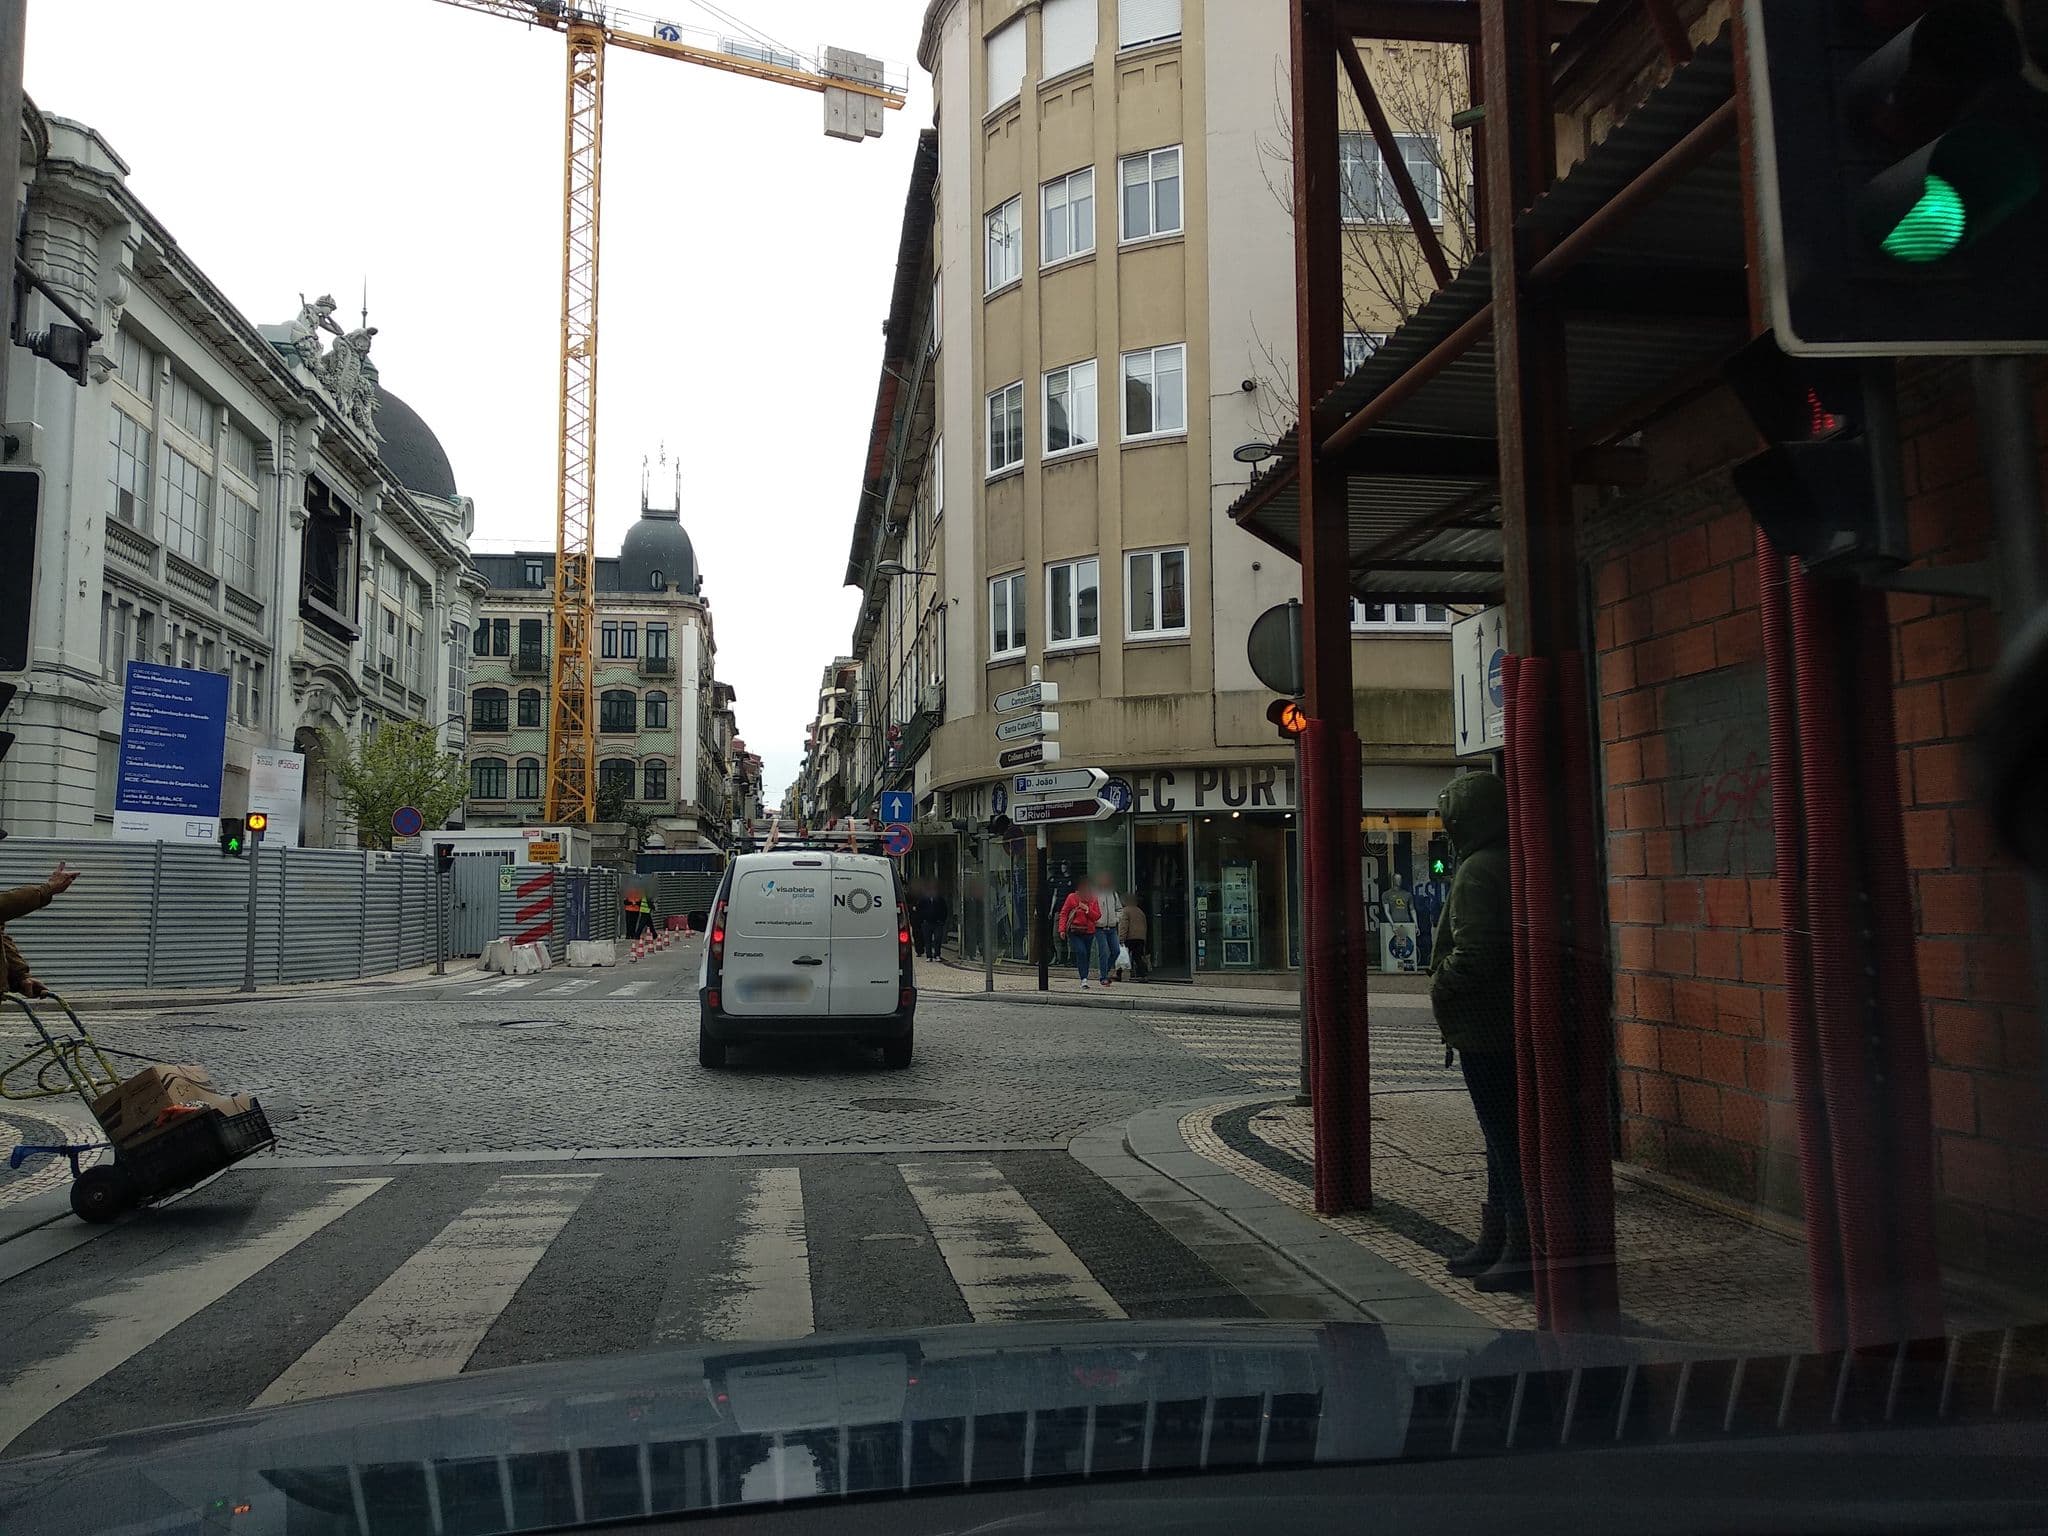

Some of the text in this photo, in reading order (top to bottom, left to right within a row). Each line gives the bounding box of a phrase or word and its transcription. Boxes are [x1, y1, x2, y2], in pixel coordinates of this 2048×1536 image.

[1004, 725, 1017, 734] Santa
[1026, 779, 1034, 787] D.
[1035, 778, 1053, 787] João
[1133, 769, 1176, 814] FC
[1195, 765, 1295, 806] PORT
[1045, 801, 1074, 809] municipal
[1027, 810, 1050, 819] Rivoli
[833, 887, 883, 914] NOS
